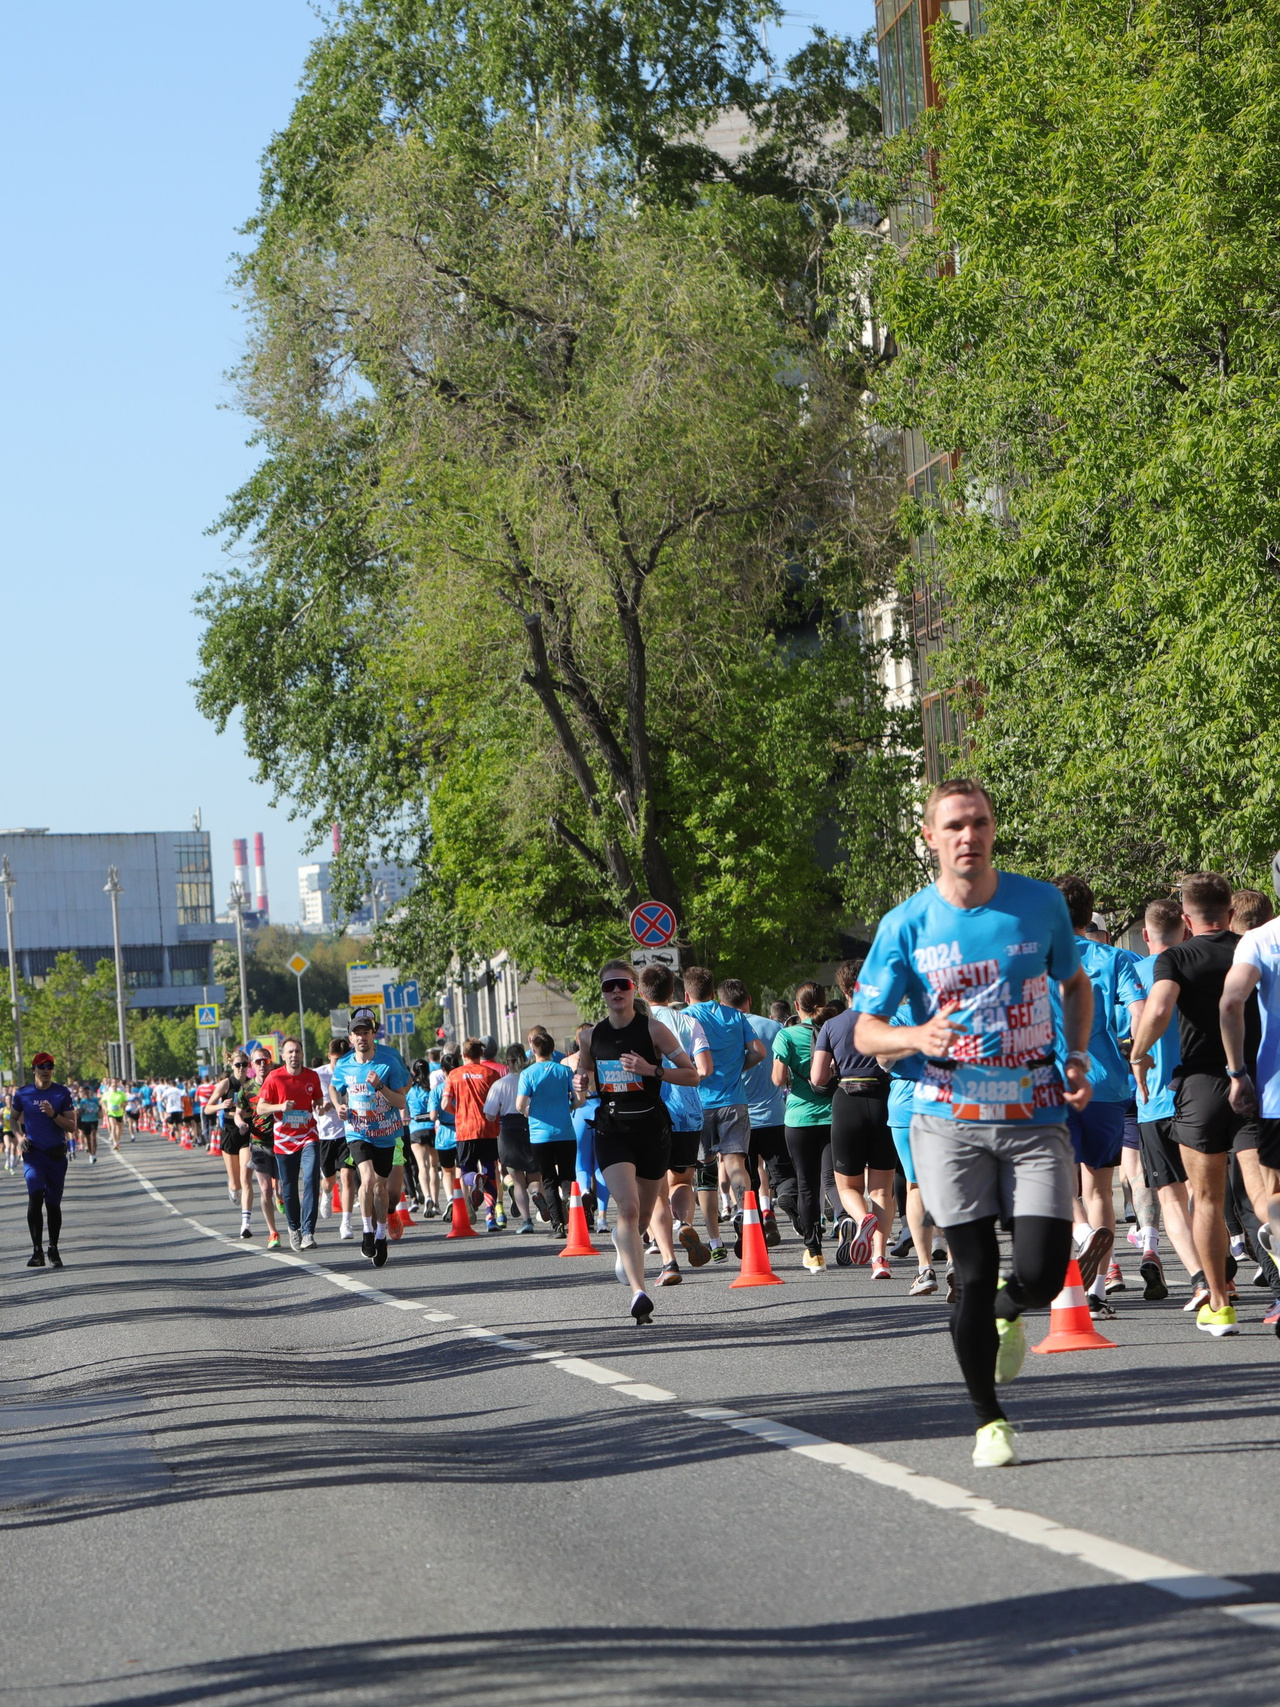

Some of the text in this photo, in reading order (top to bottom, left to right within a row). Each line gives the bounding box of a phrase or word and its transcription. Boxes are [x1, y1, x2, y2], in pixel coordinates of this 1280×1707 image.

[914, 940, 963, 974] 2024
[928, 960, 999, 993] #МЕЧТА
[966, 1081, 1019, 1102] 24828
